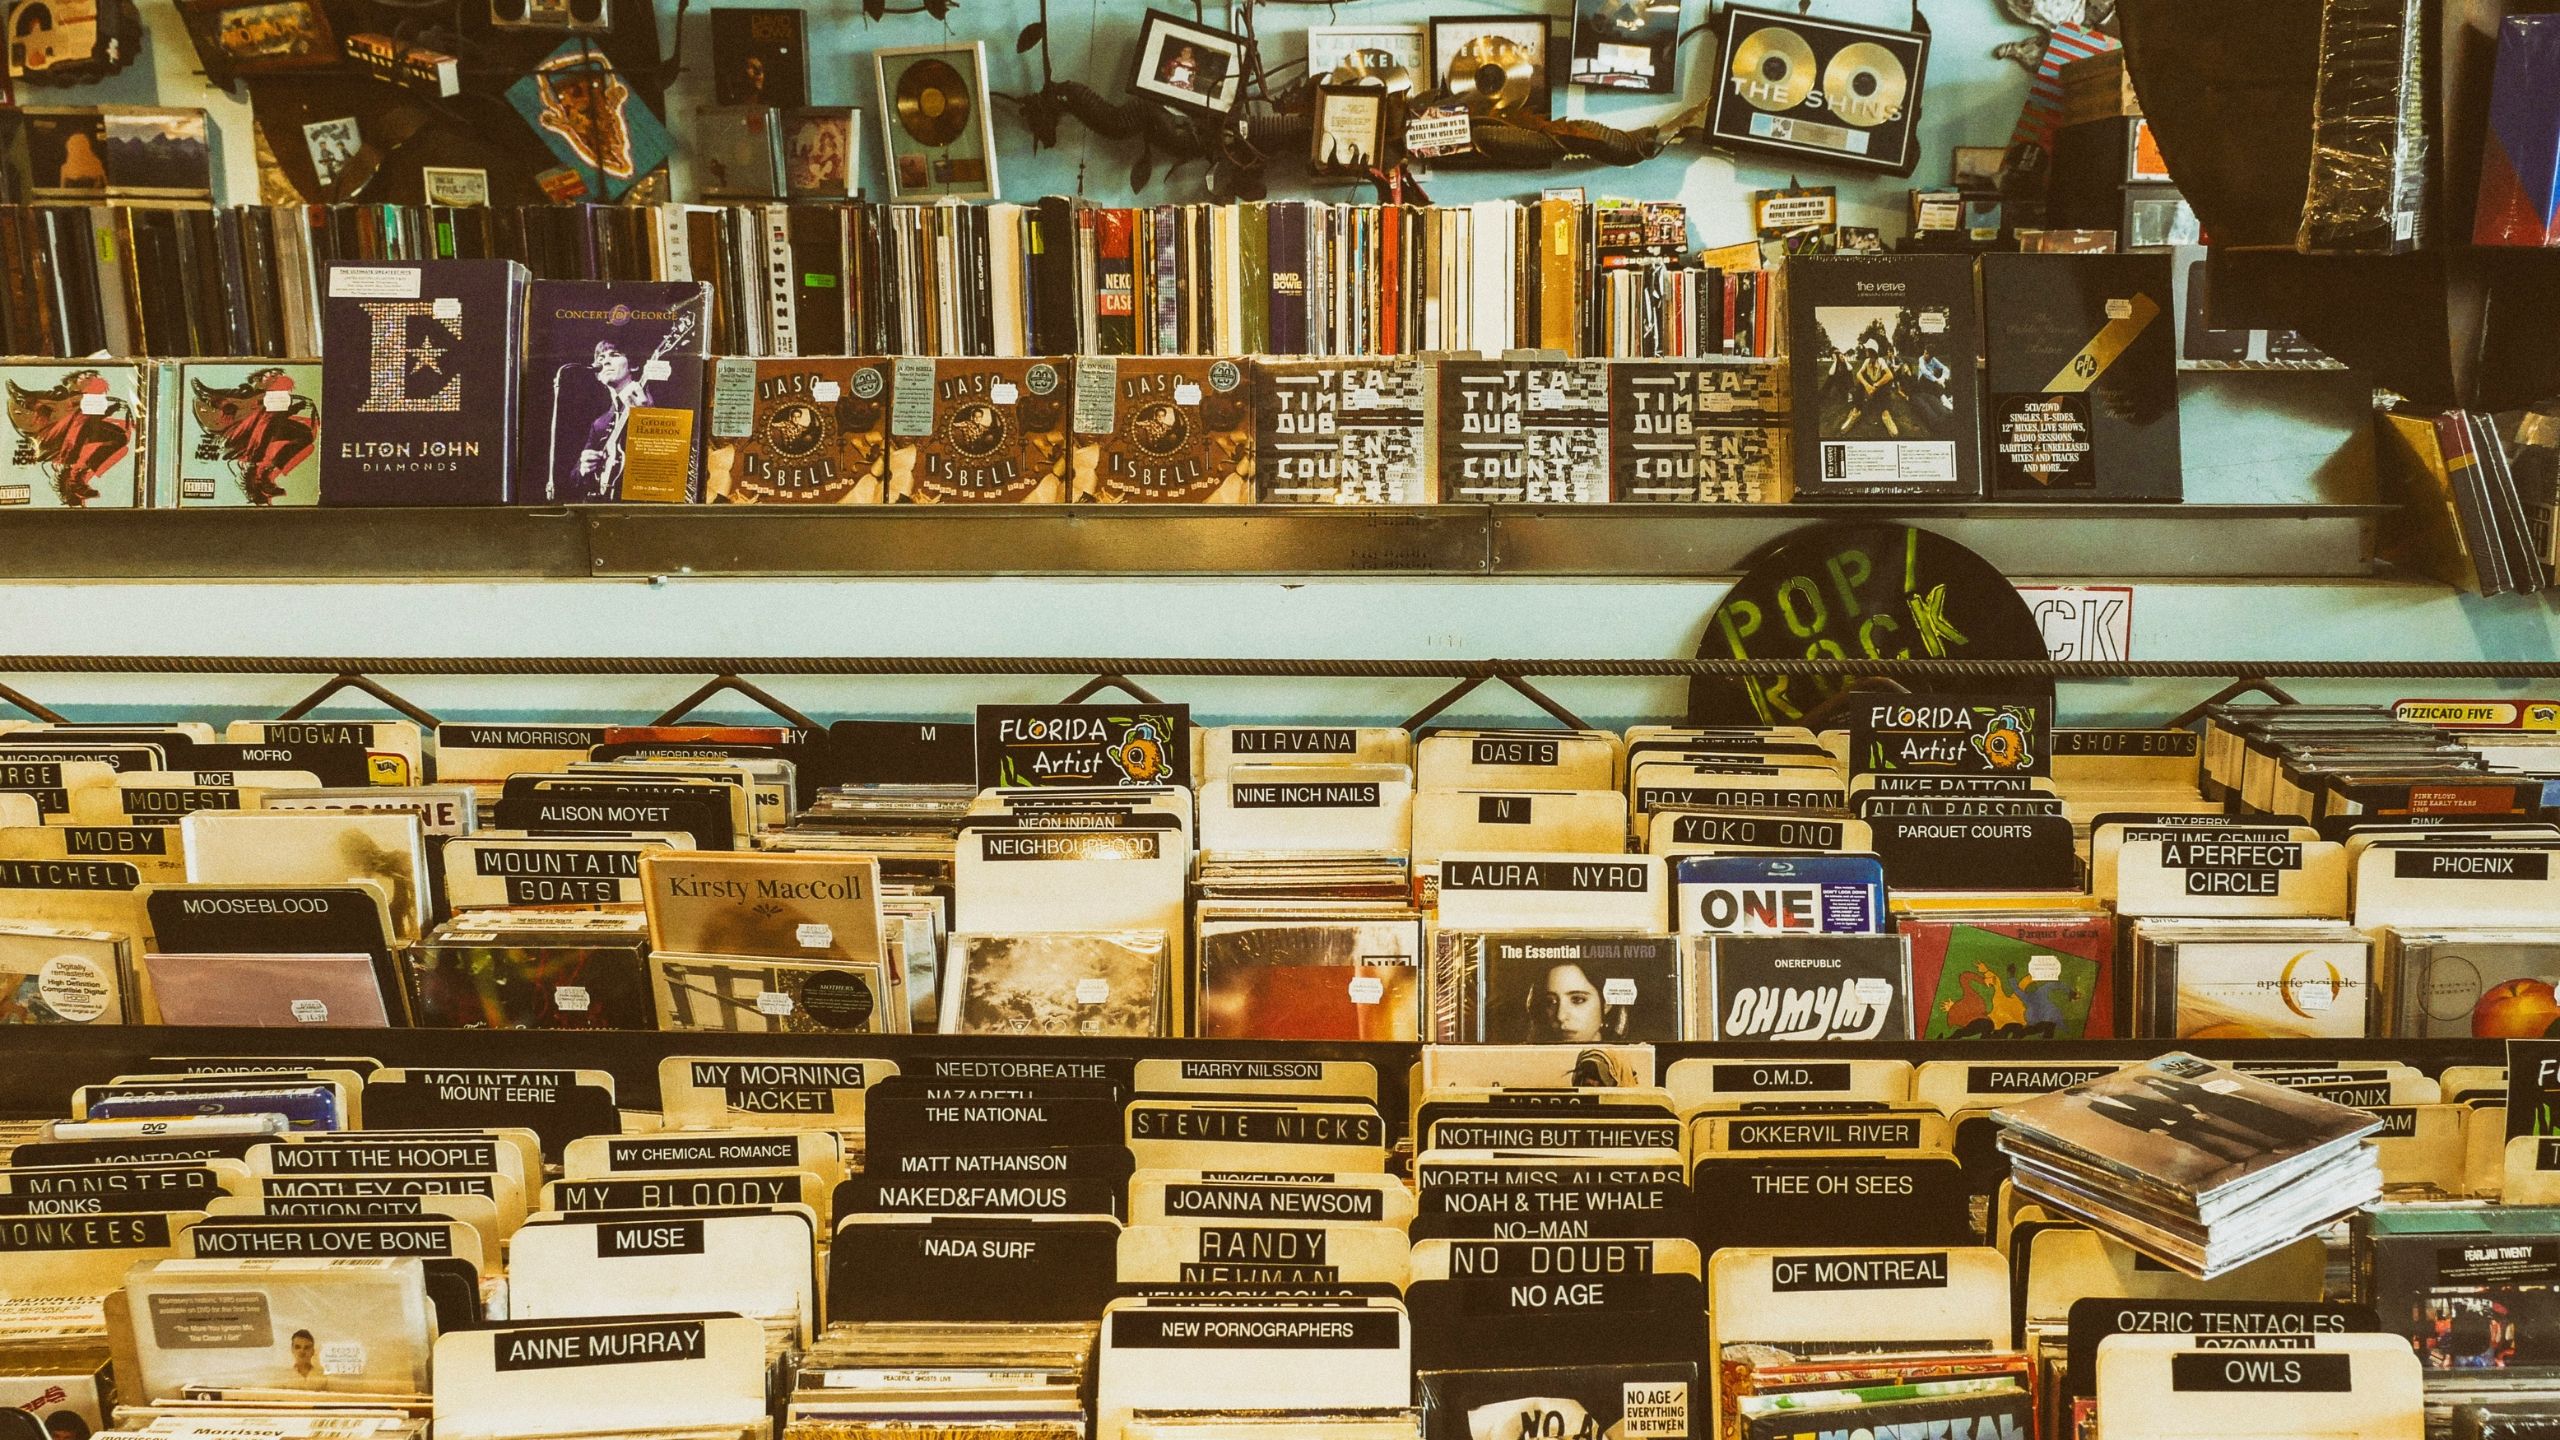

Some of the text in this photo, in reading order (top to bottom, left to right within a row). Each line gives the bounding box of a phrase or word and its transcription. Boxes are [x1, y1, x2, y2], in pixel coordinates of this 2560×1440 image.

[1730, 77, 1903, 122] THE SHINS
[1273, 273, 1298, 281] DAVID
[1273, 281, 1302, 290] BOWIE
[1857, 281, 1906, 291] the verve
[556, 308, 678, 321] CONCERT GEORGE
[2025, 403, 2059, 412] 5CD/2DVD
[1276, 413, 1335, 434] DUB
[1461, 413, 1520, 434] DUB
[1632, 414, 1692, 434] DUB
[2010, 413, 2075, 422] SINGLES, B-SIDES,
[2015, 423, 2039, 432] MIXES,
[2041, 423, 2057, 431] LIVE
[2058, 423, 2085, 432] SHOWS,
[2014, 433, 2074, 442] RADIO SESSIONS,
[342, 441, 479, 458] ELTON JOHN
[2000, 443, 2089, 452] RARITIES UNRELEASED
[2012, 454, 2033, 462] MIXES
[2051, 453, 2079, 461] TRACKS
[364, 463, 457, 472] DIAMONDS
[749, 456, 834, 487] ISBELL
[931, 457, 1016, 488] ISBELL
[1114, 455, 1199, 487] ISBELL
[2023, 464, 2038, 472] AND
[1718, 550, 1872, 661] POP
[1871, 706, 1972, 730] FLORIDA
[2399, 707, 2493, 719] PIZZICATO FIVE
[271, 725, 365, 745] MOGWAI
[471, 730, 591, 745] VAN MORRISON
[921, 727, 936, 741] M
[1000, 718, 1108, 742] FLORIDA
[1240, 732, 1351, 751] NIRVANA
[1900, 737, 1967, 761] Artist
[243, 749, 292, 762] MOFRO
[1032, 751, 1103, 774] Artist
[1480, 744, 1555, 762] OASIS
[199, 773, 231, 786] MOE
[1236, 786, 1375, 804] NINE INCH NAILS
[540, 806, 670, 822] ALISON MOYET
[1497, 799, 1510, 819] N
[75, 831, 154, 851] MOBY
[1684, 821, 1833, 846] YOKO ONO
[1898, 824, 2032, 839] PARQUET COURTS
[483, 851, 638, 875] MOUNTAIN
[2166, 846, 2299, 866] A PERFECT
[2433, 857, 2514, 874] PHOENIX
[1451, 866, 1643, 888] LAURA NYRO
[2189, 873, 2275, 893] CIRCLE
[520, 881, 611, 901] GOATS
[670, 875, 862, 904] Kirsty MacColl
[183, 898, 328, 915] MOOSEBLOOD
[1701, 890, 1815, 928] ONE
[1501, 945, 1581, 959] The Essential
[1775, 958, 1842, 969] ONEREPUBLIC
[695, 1065, 861, 1086] MY MORNING
[1187, 1064, 1318, 1078] HARRY NILSSON
[1753, 1070, 1814, 1086] O.M.D.
[440, 1086, 556, 1103] MOUNT EERIE
[732, 1091, 827, 1111] JACKET
[925, 1107, 1047, 1122] THE NATIONAL
[141, 1123, 168, 1136] DVD
[1440, 1129, 1674, 1147] NOTHING BUT THIEVES
[1741, 1125, 1909, 1144] OKKERVIL RIVER
[278, 1148, 490, 1168] MOTT THE HOOPLE
[616, 1144, 792, 1161] MY CHEMICAL ROMANCE
[901, 1155, 1067, 1172] MATT NATHANSON
[1752, 1175, 1913, 1194] THEE OH SEES
[879, 1187, 1067, 1208] NAKED&FAMOUS
[1173, 1191, 1372, 1214] JOANNA NEWSOM
[1445, 1191, 1664, 1212] NOAH & THE WHALE
[200, 1231, 447, 1251] MOTHER LOVE BONE
[616, 1228, 685, 1249] MUSE
[1203, 1231, 1323, 1259] RANDY
[925, 1240, 1036, 1259] NADA SURF
[1455, 1245, 1651, 1274] NO DOUBT
[1776, 1259, 1945, 1285] OF MONTREAL
[1511, 1284, 1604, 1307] NO AGE
[1162, 1322, 1354, 1338] NEW PORNOGRAPHERS
[509, 1330, 700, 1361] ANNE MURRAY
[2225, 1360, 2301, 1384] OWLS
[1627, 1390, 1670, 1404] NO AGE
[1627, 1405, 1685, 1419] EVERYTHING
[1627, 1418, 1684, 1432] IN BETWEEN
